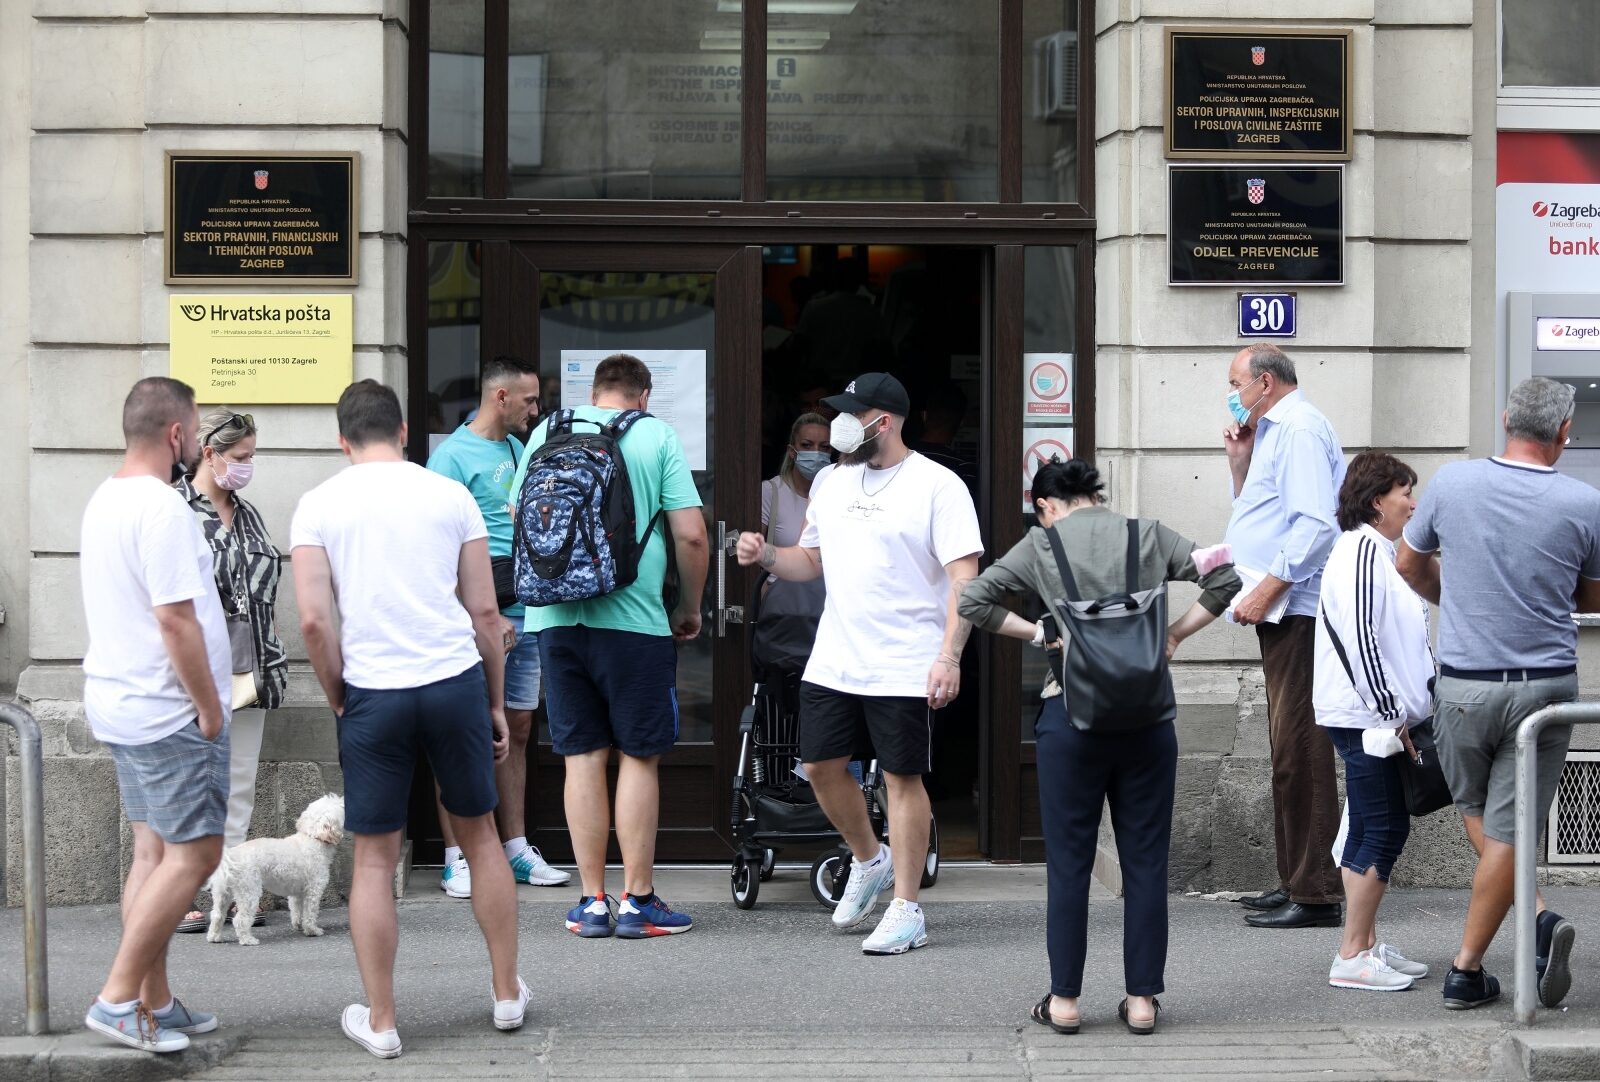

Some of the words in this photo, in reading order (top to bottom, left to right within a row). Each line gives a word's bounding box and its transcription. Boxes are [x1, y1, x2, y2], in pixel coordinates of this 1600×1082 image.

[1199, 95, 1239, 103] POLICIJSKA
[1269, 95, 1315, 104] ZAGREBAČKA
[1176, 106, 1214, 117] SEKTOR
[1216, 107, 1267, 119] UPRAVNIH,
[1269, 107, 1340, 118] INSPEKCIJSKIH
[1194, 120, 1198, 130] I
[1200, 120, 1244, 131] POSLOVA
[1246, 120, 1282, 131] CIVILNE
[1284, 119, 1322, 131] ZAŠTITE
[1237, 133, 1281, 144] ZAGREB
[201, 220, 242, 228] POLICIJSKA
[243, 220, 272, 228] UPRAVA
[272, 219, 320, 228] ZAGREBAČKA
[1575, 221, 1593, 230] Group
[183, 231, 222, 242] SEKTOR
[223, 232, 270, 244] PRAVNIH,
[272, 231, 339, 242] FINANCIJSKIH
[1267, 232, 1313, 241] ZAGREBAČKA
[208, 245, 213, 256] I
[214, 243, 267, 256] TEHNIČKIH
[268, 245, 314, 256] POSLOVA
[1193, 246, 1236, 258] ODJEL
[1240, 246, 1319, 258] PREVENCIJE
[239, 258, 285, 269] ZAGREB
[1237, 262, 1275, 270] ZAGREB
[210, 304, 281, 321] Hrvatska
[285, 303, 331, 323] pošta
[1250, 297, 1285, 331] 30
[211, 357, 248, 366] Poštanski
[249, 357, 267, 366] ured
[268, 357, 290, 366] 10130
[291, 357, 318, 367] Zagreb
[211, 368, 246, 377] Petrinjska
[247, 368, 257, 376] 30
[211, 379, 237, 388] Zagreb
[493, 460, 516, 483] CONVE
